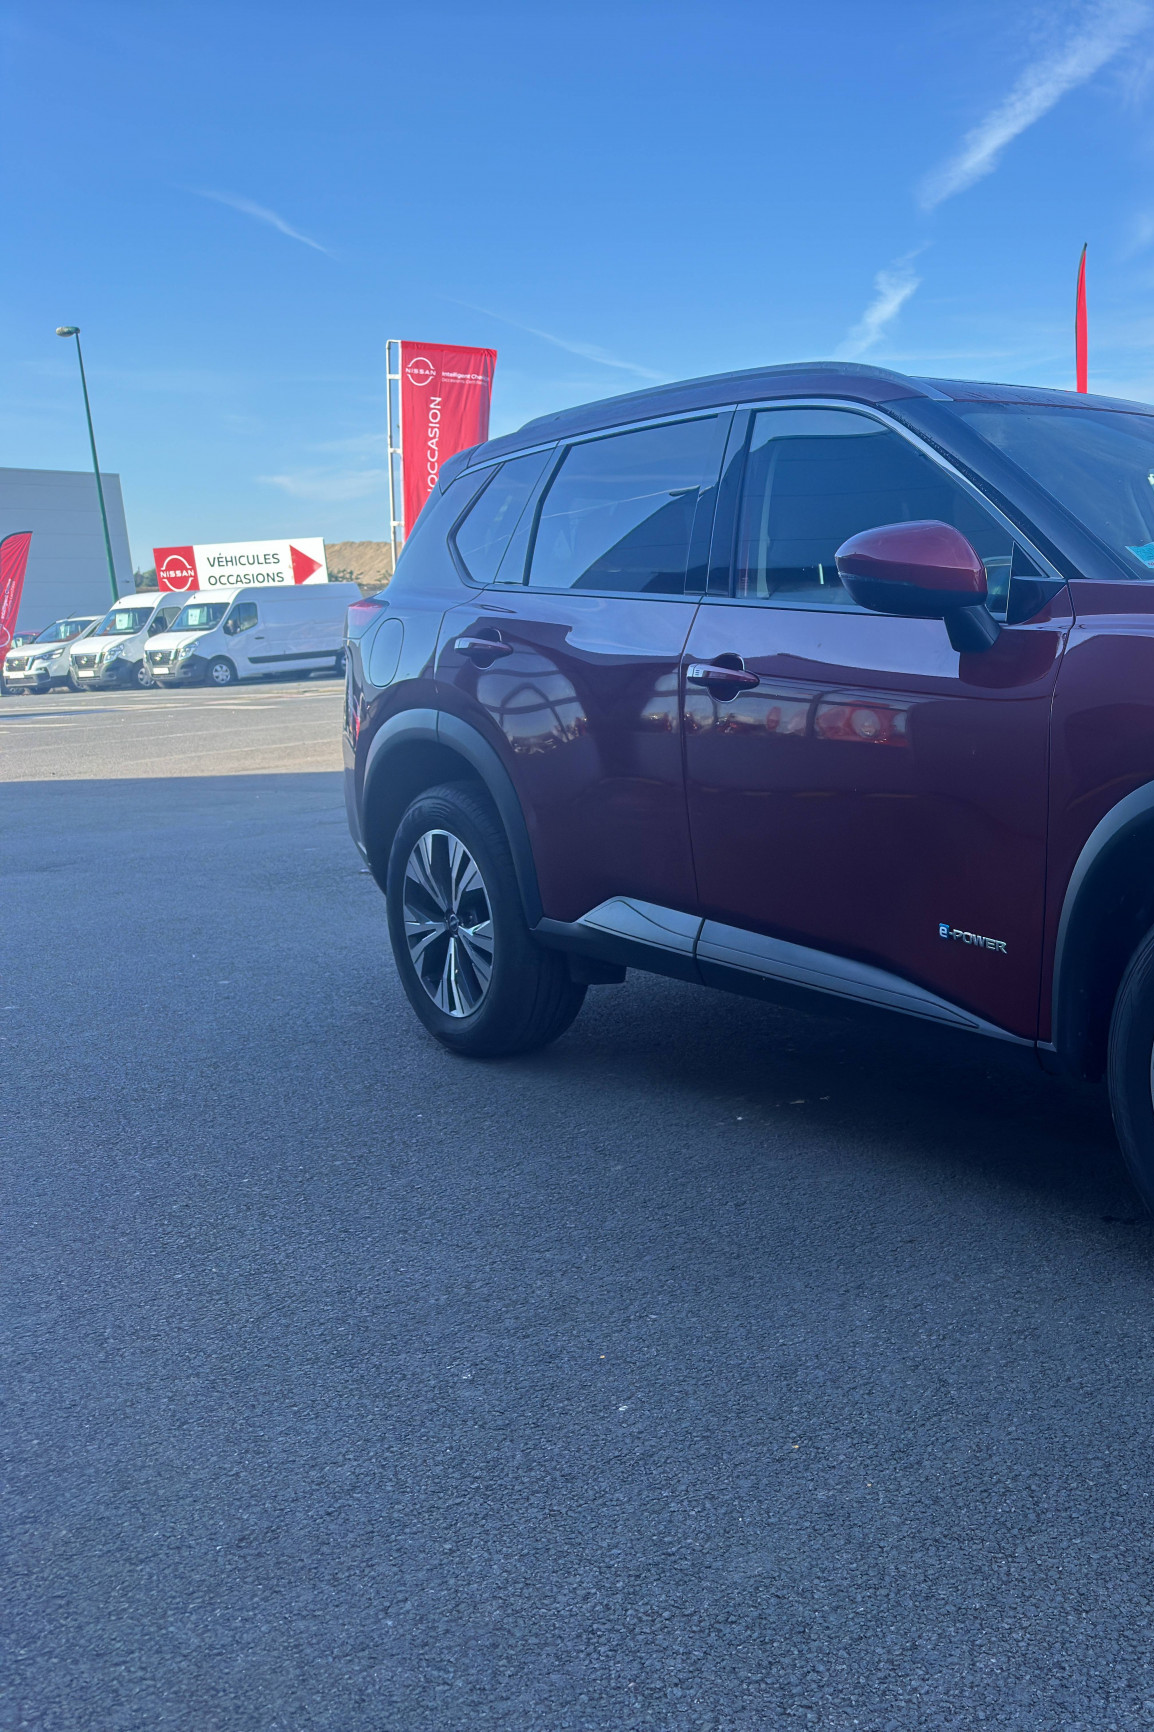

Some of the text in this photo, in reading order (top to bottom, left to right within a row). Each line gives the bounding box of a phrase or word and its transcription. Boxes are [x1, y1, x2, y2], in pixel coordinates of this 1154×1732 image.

[405, 367, 436, 376] NISSAN
[206, 552, 281, 568] VÉHICULES
[160, 569, 195, 578] NISSAN
[207, 571, 285, 586] OCCASIONS
[939, 923, 1008, 954] e-POWER
